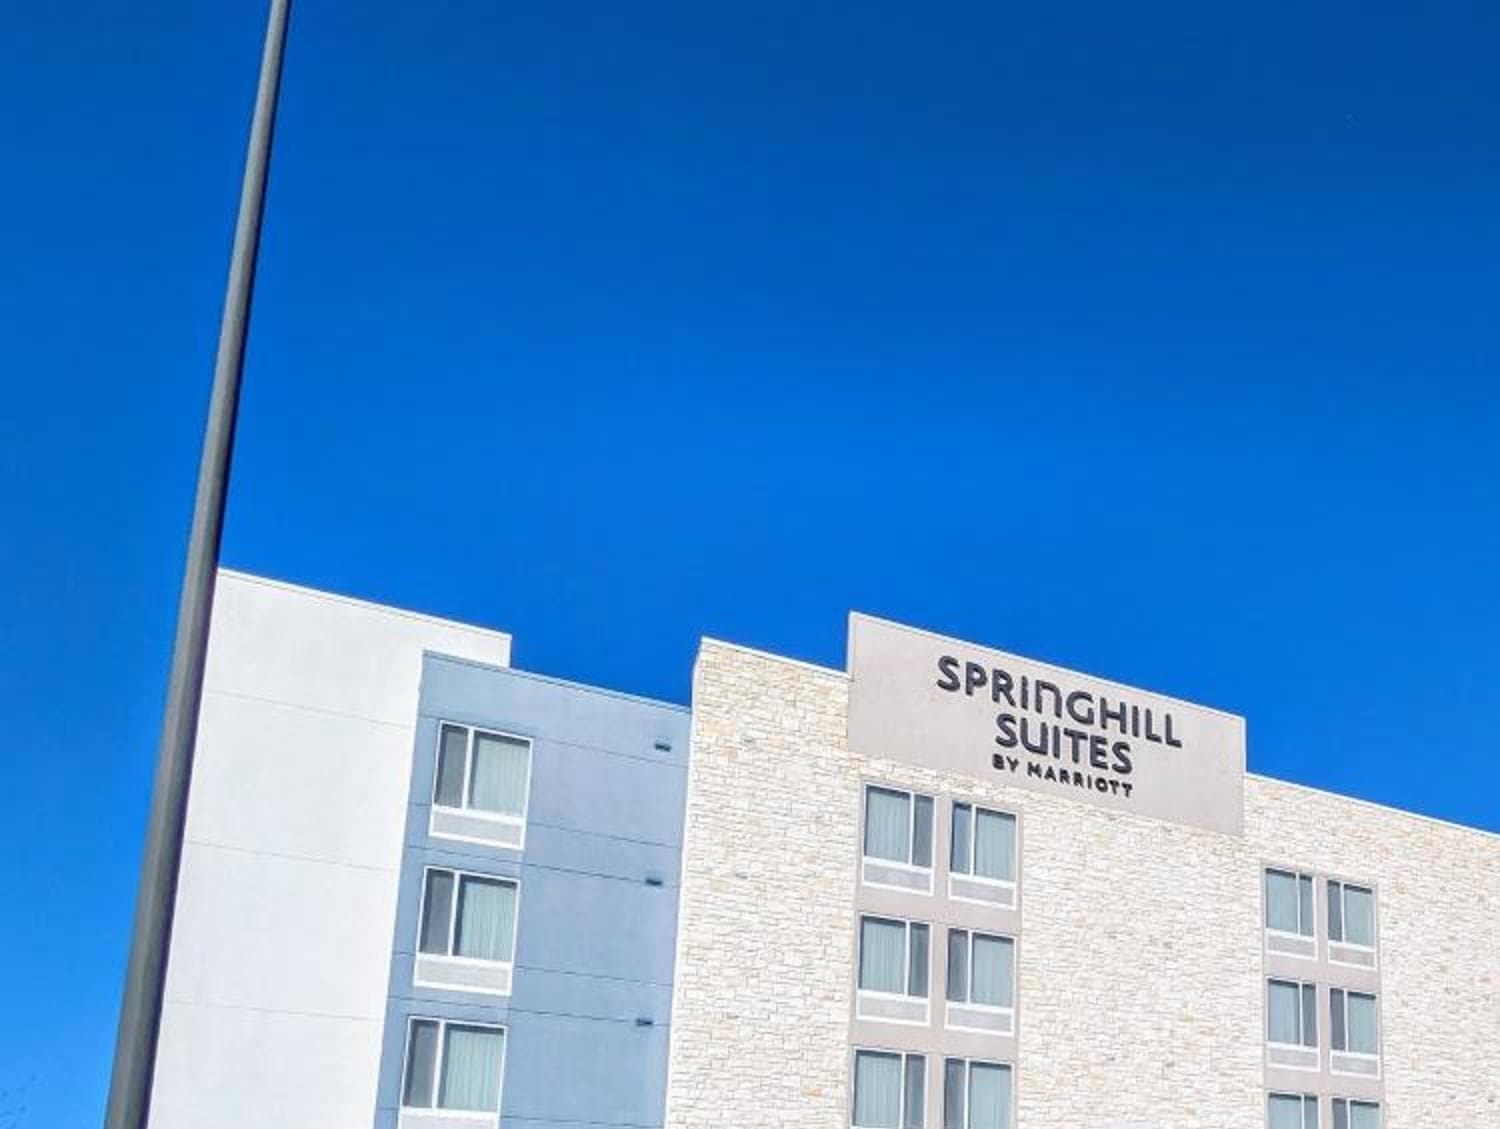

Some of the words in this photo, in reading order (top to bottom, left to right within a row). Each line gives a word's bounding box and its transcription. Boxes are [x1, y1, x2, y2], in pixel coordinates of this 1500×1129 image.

[937, 655, 1183, 748] SPRINGHILL
[995, 714, 1134, 775] SUITES
[992, 754, 1019, 773] BY
[1027, 761, 1134, 798] MARRIOTT
